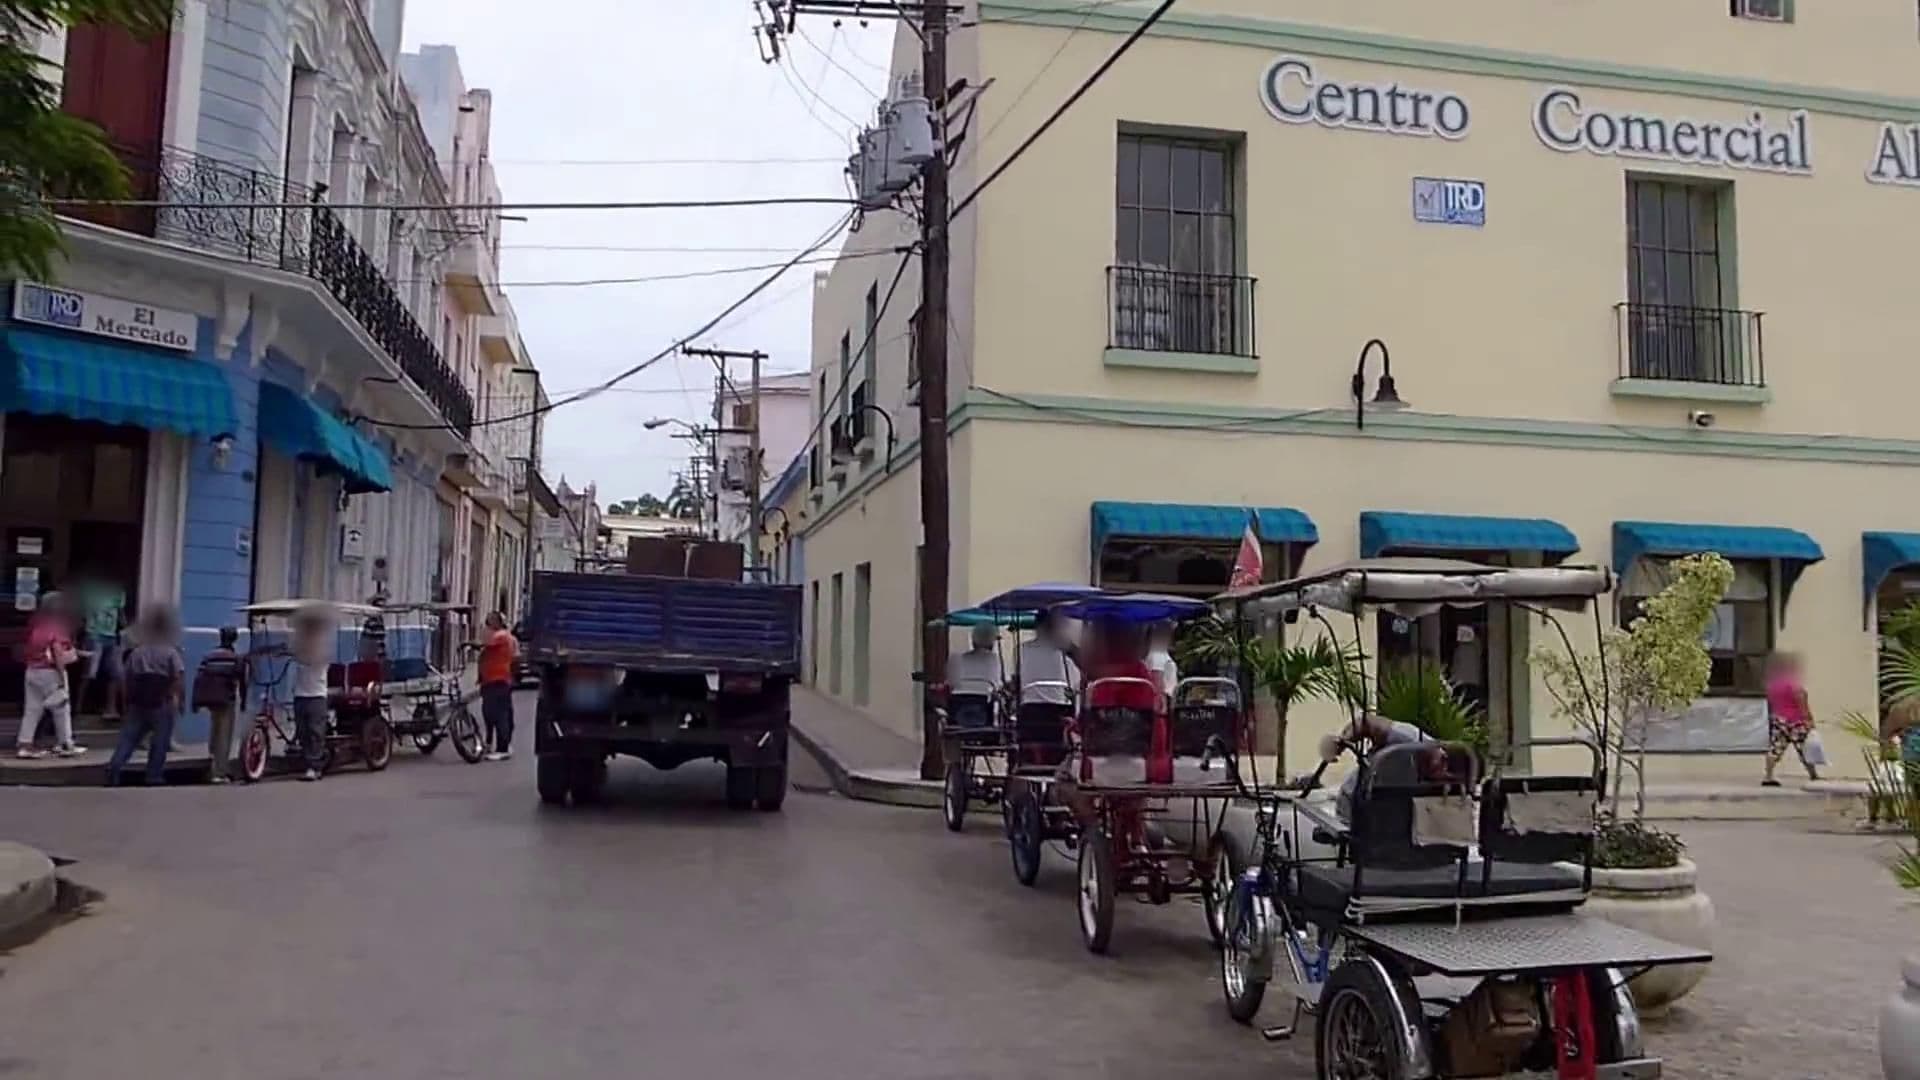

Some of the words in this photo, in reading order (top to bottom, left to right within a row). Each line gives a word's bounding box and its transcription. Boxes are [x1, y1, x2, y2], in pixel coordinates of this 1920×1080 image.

[1264, 58, 1469, 135] Centro
[1538, 92, 1811, 170] Comercial
[1436, 182, 1483, 210] TRD
[134, 307, 156, 325] El
[95, 316, 188, 346] Mercado
